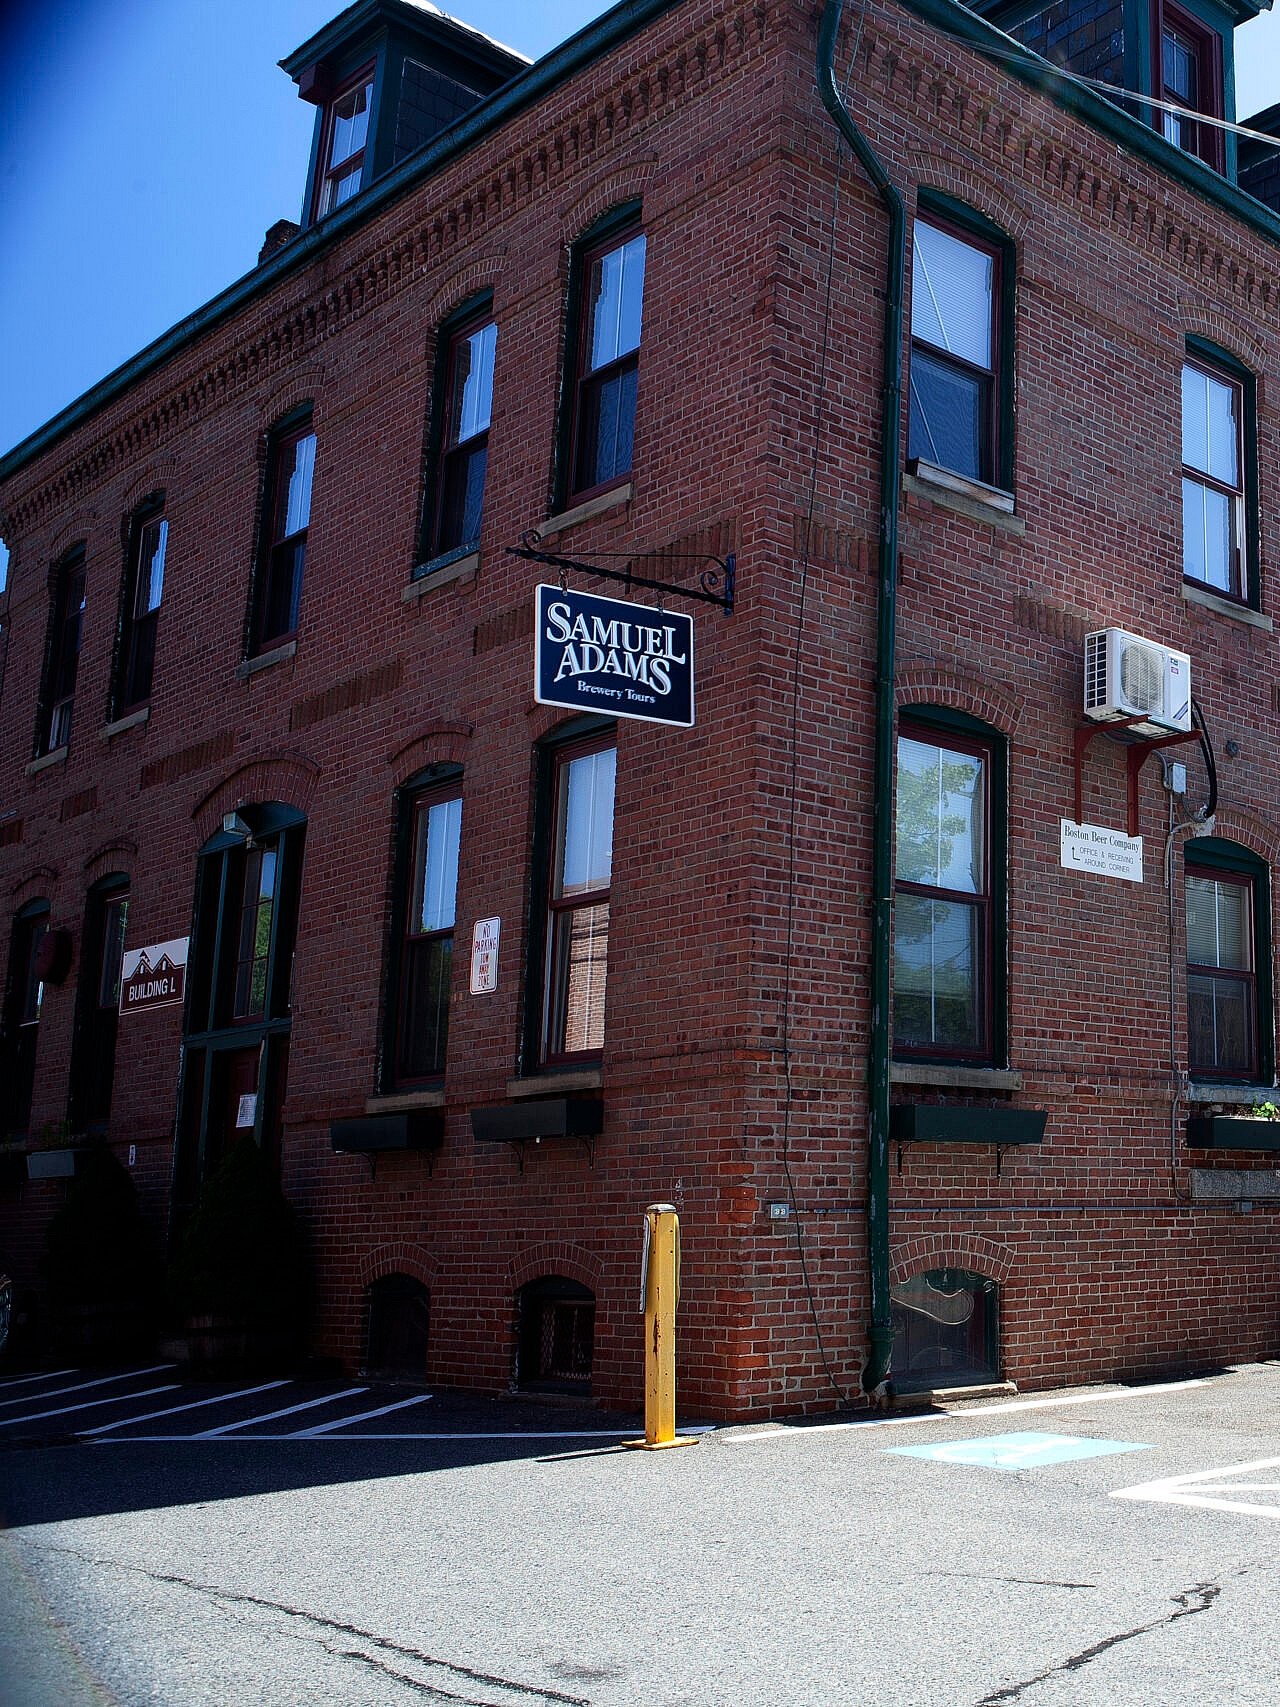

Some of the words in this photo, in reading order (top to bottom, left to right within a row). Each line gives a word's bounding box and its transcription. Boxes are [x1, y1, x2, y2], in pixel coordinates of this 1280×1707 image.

[546, 602, 686, 665] SAMUEL
[553, 642, 672, 696] ADAMS
[577, 680, 623, 699] Brewery
[624, 688, 656, 704] Tours
[1064, 825, 1089, 840] Boston
[1091, 831, 1108, 845] Beer
[1109, 835, 1140, 853] Company
[1079, 846, 1098, 857] OFFICE
[1084, 859, 1106, 868] AROUND
[1108, 863, 1130, 873] CORNER
[128, 977, 168, 1001] BUILDING
[170, 977, 176, 993] L
